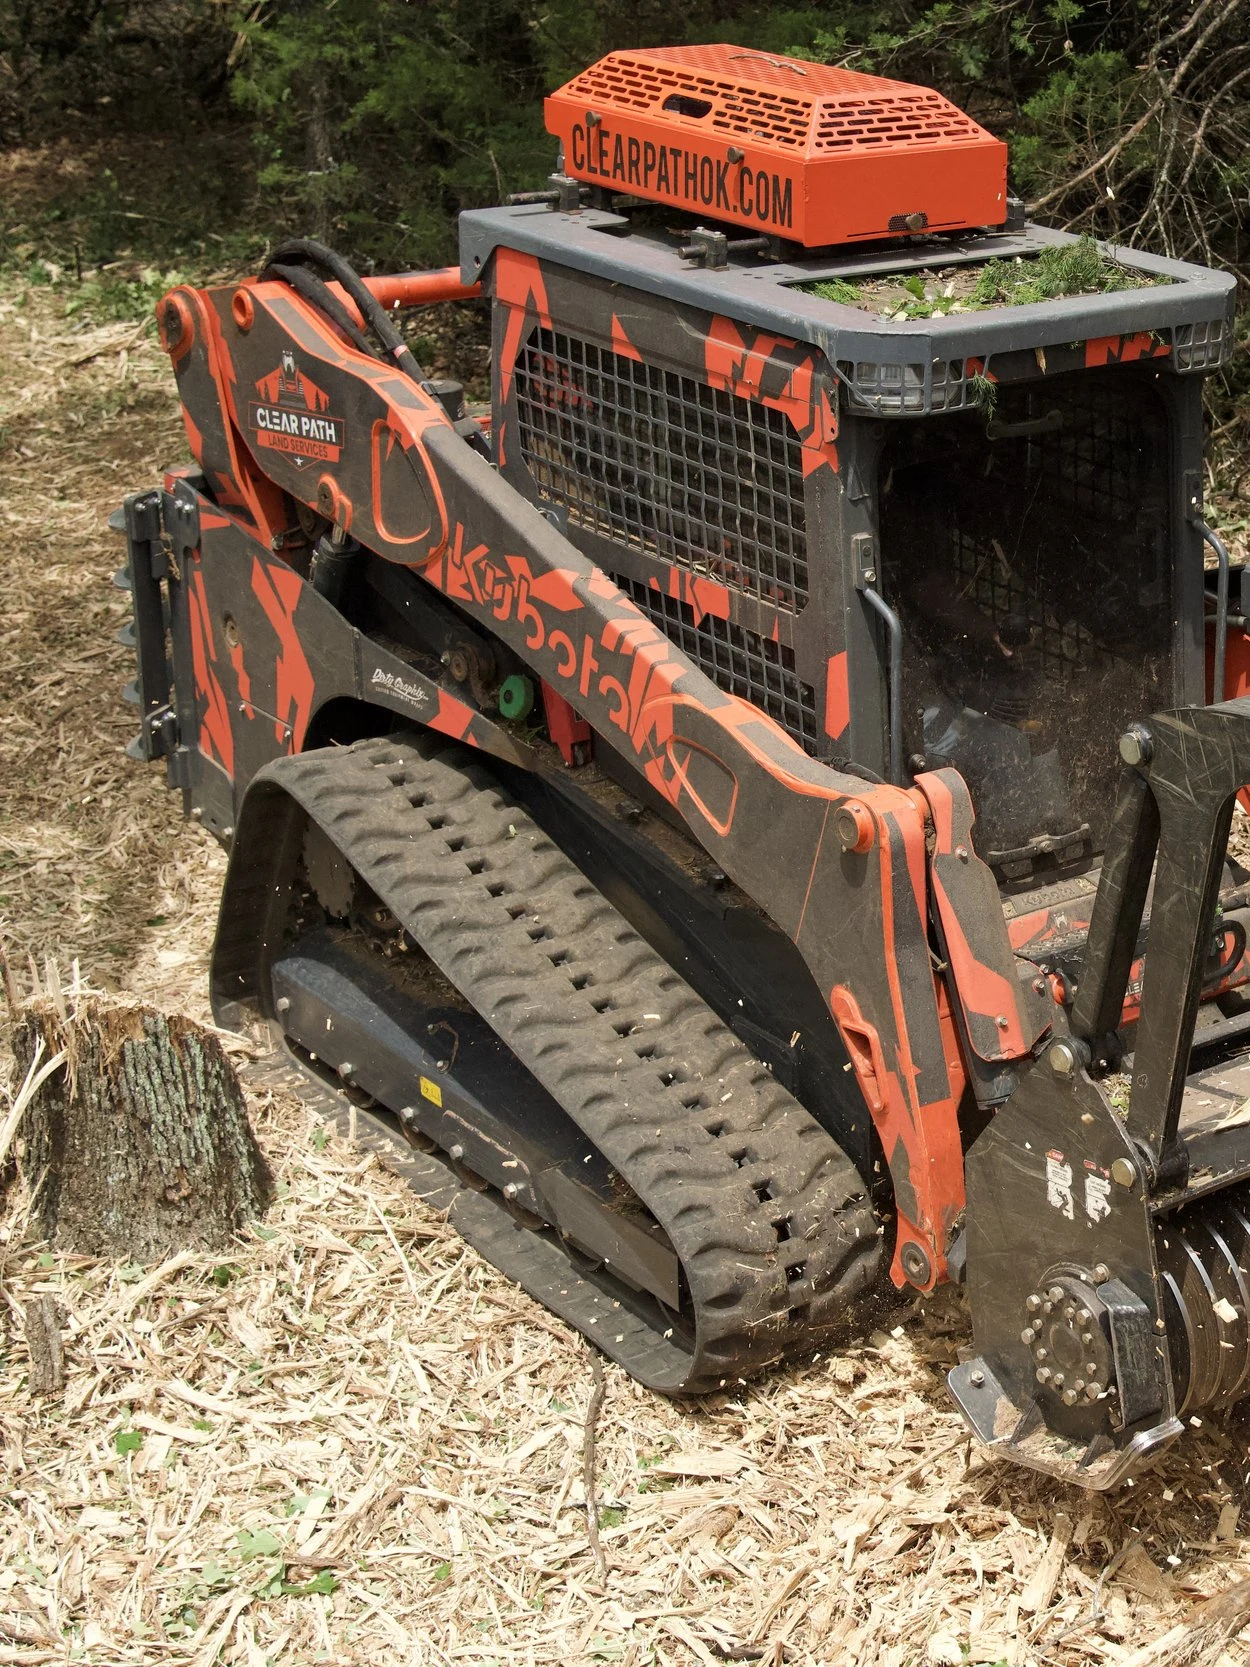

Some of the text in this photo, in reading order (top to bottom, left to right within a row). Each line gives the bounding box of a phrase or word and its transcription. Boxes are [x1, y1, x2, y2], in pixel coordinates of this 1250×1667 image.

[572, 123, 793, 228] CLEARPATHOK.COM
[256, 408, 336, 442] CLEAR PATH
[268, 434, 327, 457] LAND SERVICES
